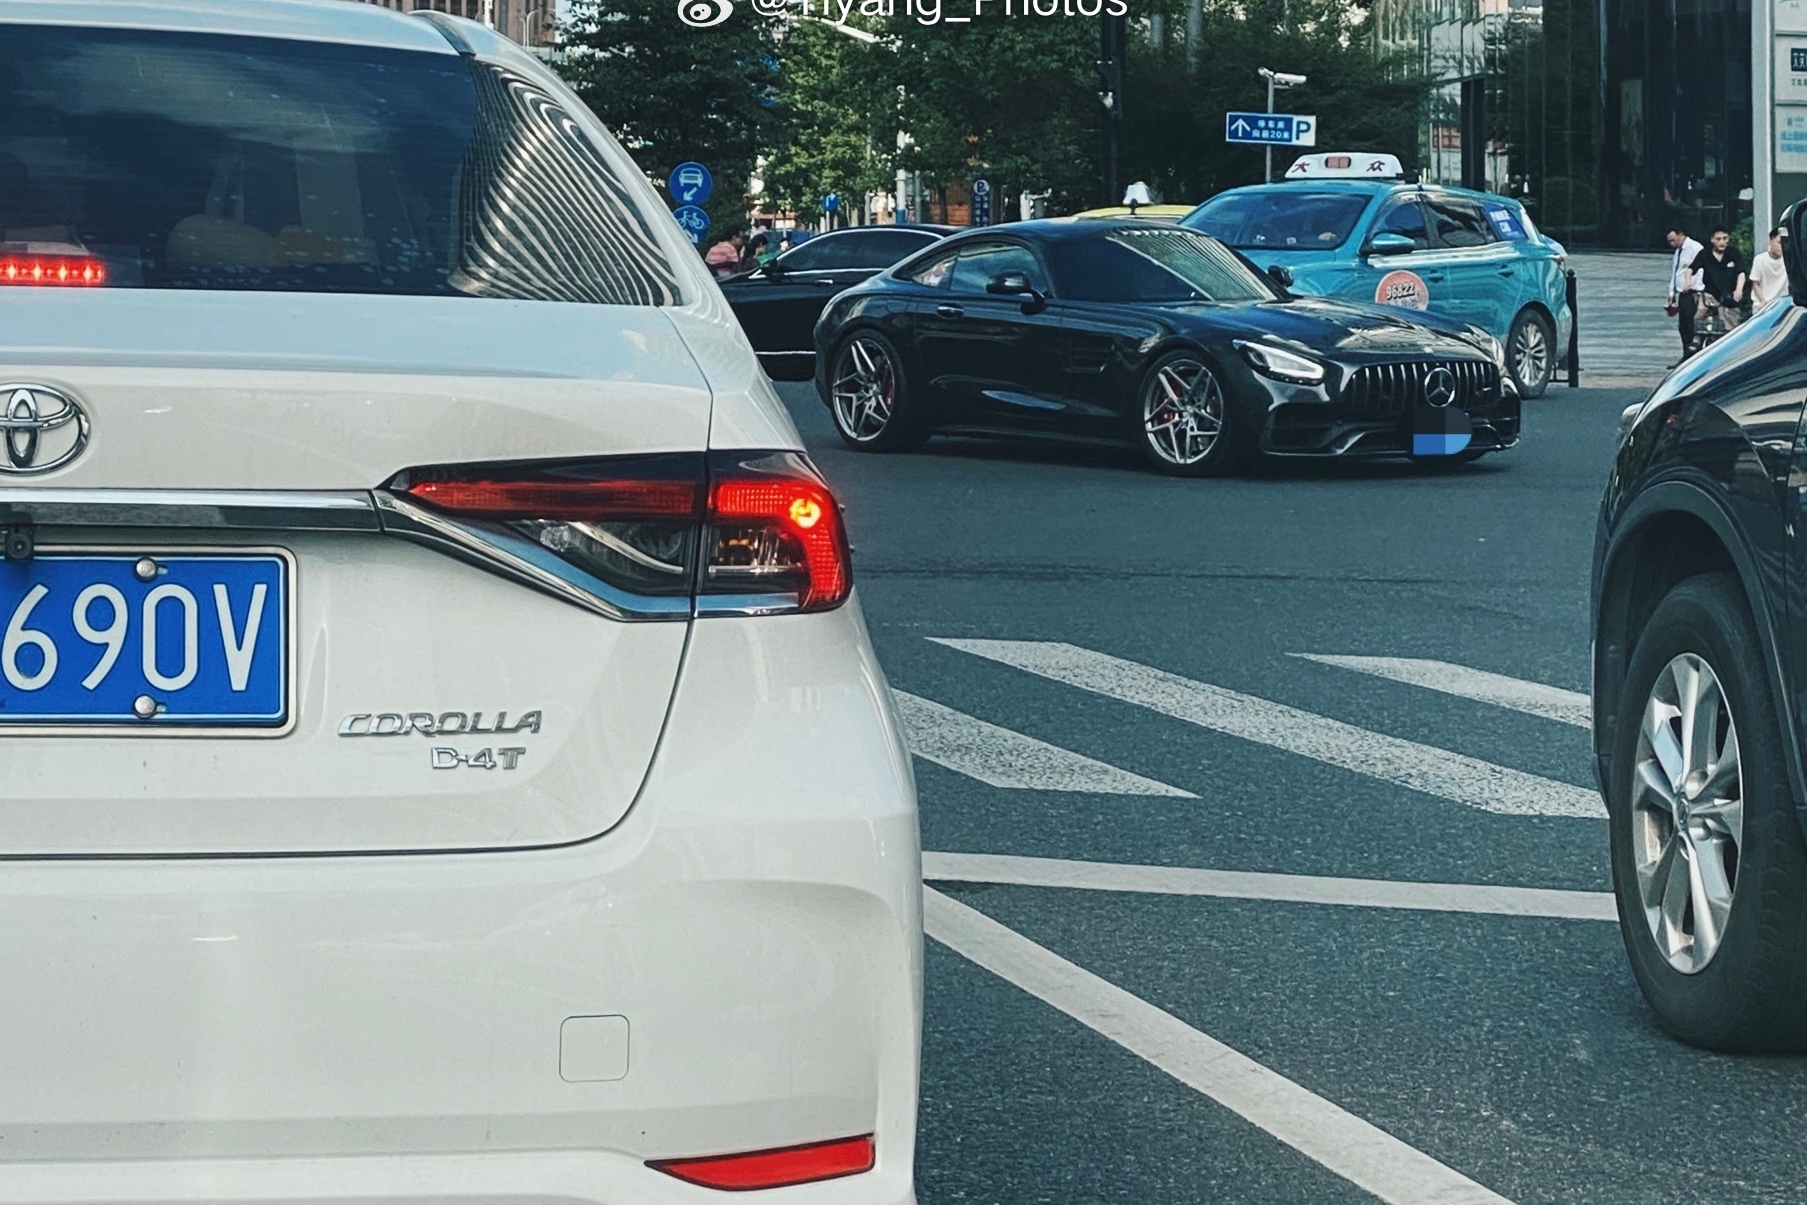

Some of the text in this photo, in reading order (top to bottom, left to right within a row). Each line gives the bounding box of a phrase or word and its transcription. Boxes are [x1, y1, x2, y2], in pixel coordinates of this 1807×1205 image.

[1295, 120, 1312, 140] P
[1386, 282, 1415, 301] 96822
[1, 583, 268, 692] 690V
[338, 710, 543, 738] COROLLA
